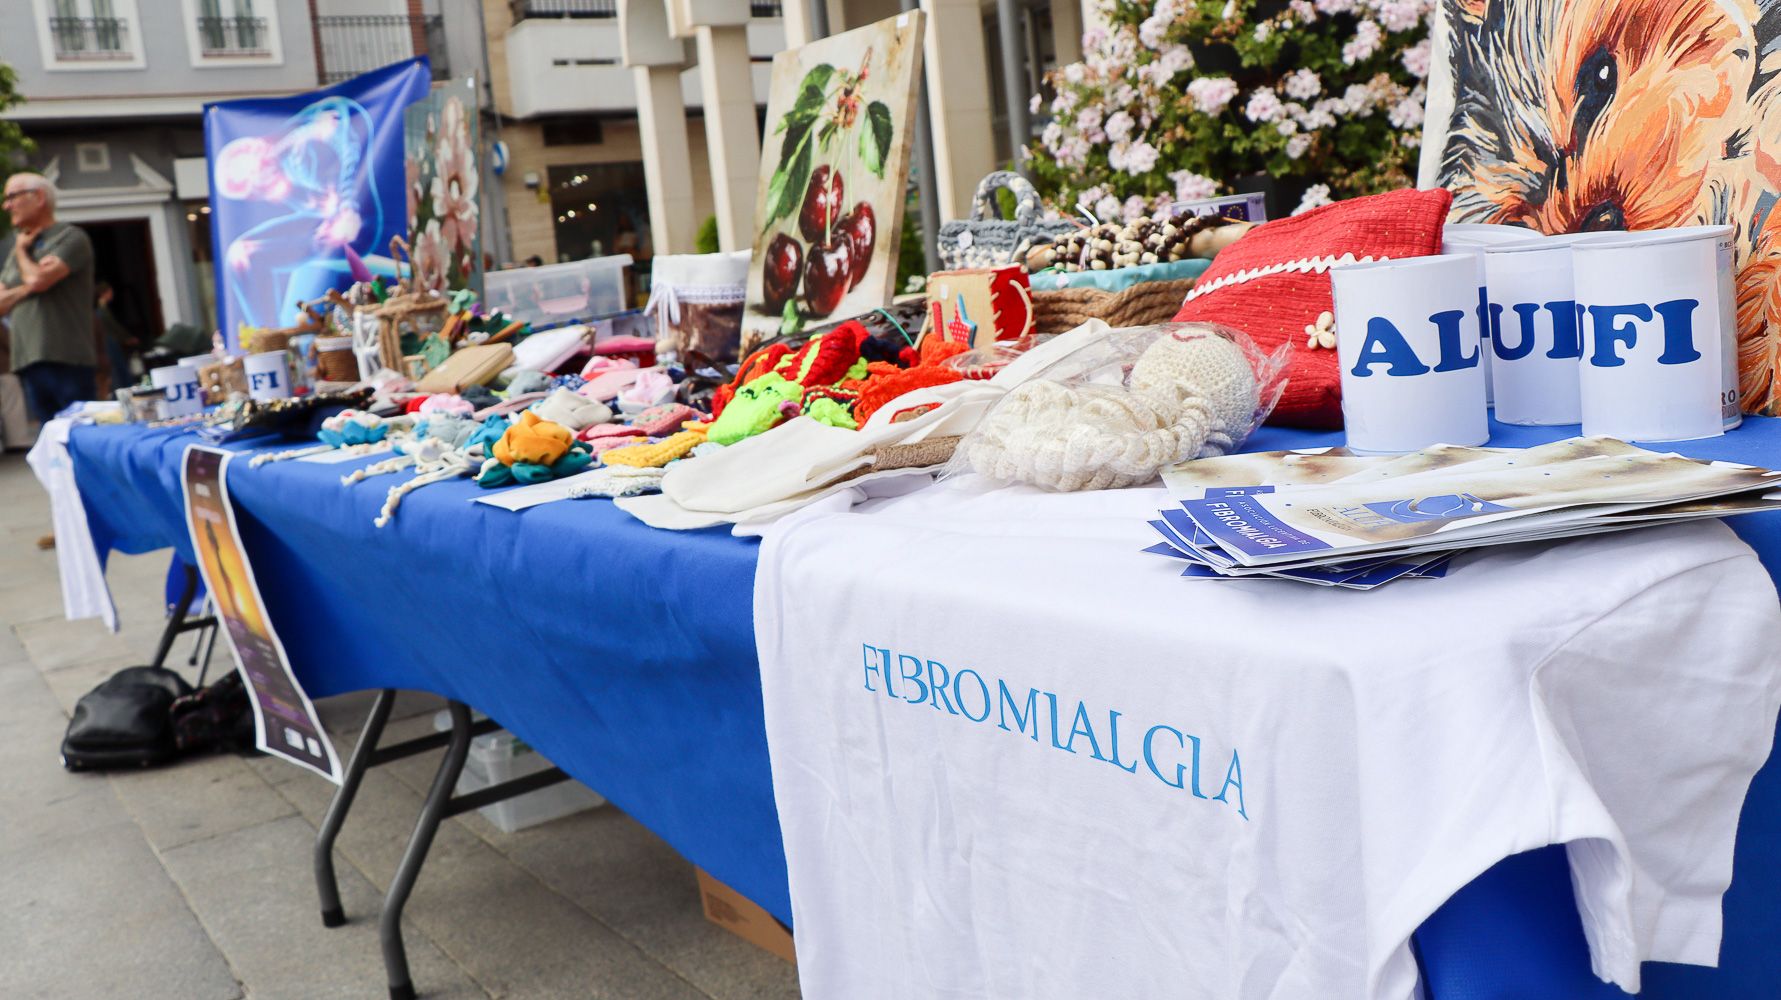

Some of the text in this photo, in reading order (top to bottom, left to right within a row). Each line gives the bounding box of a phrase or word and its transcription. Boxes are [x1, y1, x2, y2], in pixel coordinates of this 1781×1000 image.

[252, 371, 279, 390] FI
[1206, 502, 1288, 549] FIBROMIALGIA
[862, 642, 1249, 821] FIBROMIALGIA
